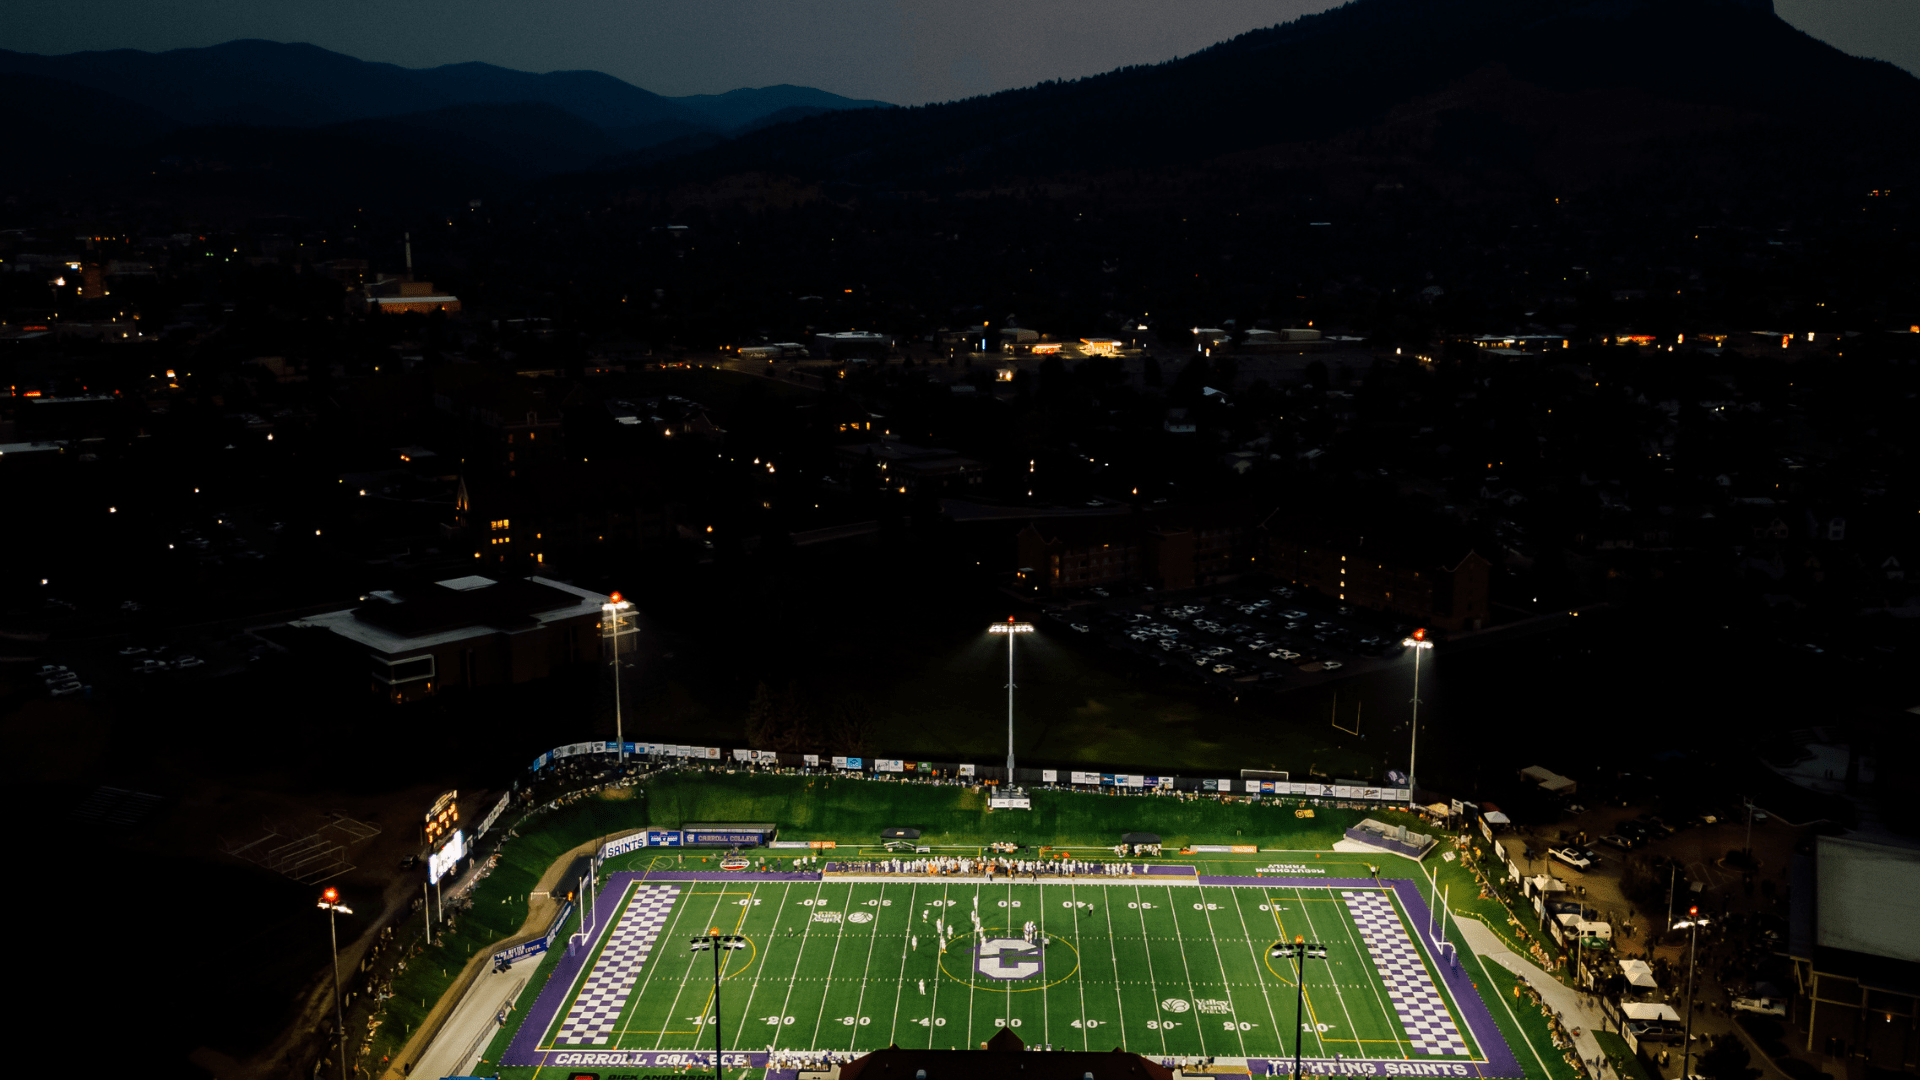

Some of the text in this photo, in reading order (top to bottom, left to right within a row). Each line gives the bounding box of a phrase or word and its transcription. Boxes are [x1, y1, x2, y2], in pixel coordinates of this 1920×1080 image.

[608, 839, 644, 857] SAINTS
[1195, 999, 1228, 1007] Valley
[766, 1016, 795, 1025] 20
[843, 1016, 870, 1026] 30
[919, 1018, 946, 1026] 40
[994, 1018, 1022, 1027] 50
[1070, 1019, 1098, 1028] 40
[1146, 1020, 1174, 1030] 30
[1223, 1022, 1251, 1031] 20
[1301, 1022, 1328, 1032] 10
[554, 1053, 648, 1066] CARROLL
[1384, 1062, 1468, 1076] SAINTS
